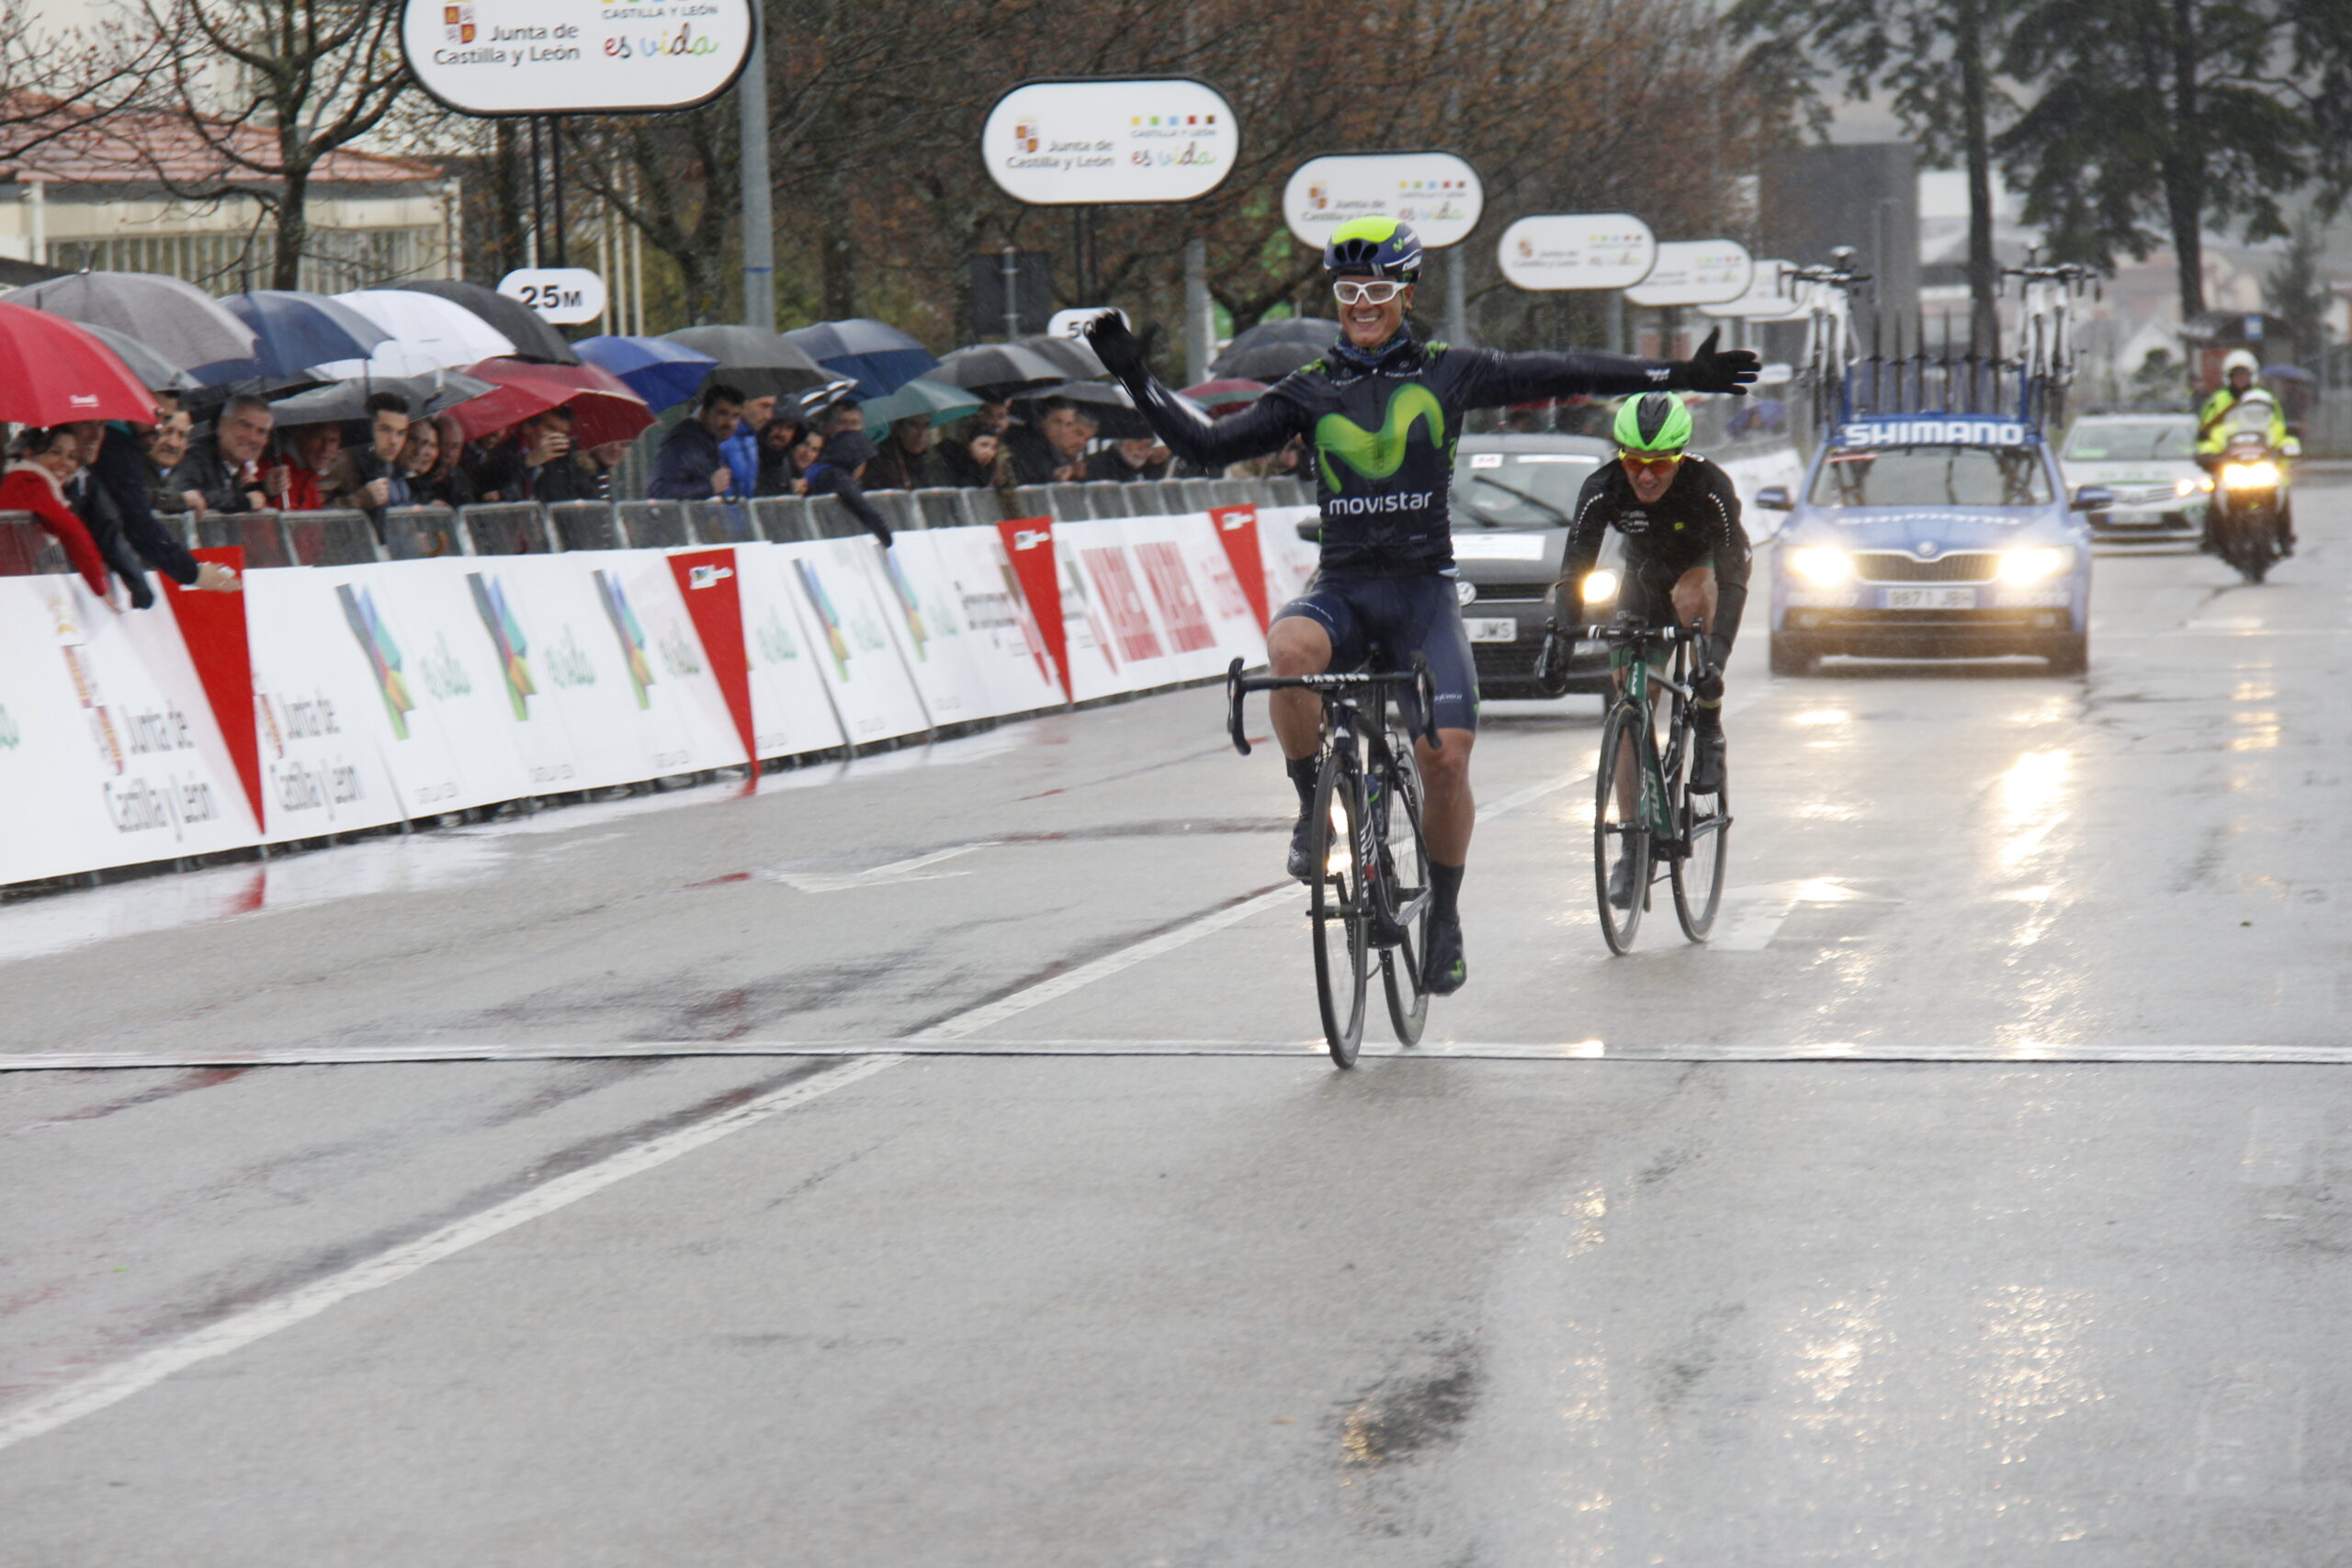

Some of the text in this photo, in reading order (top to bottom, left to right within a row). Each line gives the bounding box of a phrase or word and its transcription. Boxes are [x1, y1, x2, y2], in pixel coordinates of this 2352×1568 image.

[603, 7, 663, 18] CASTILLA
[669, 7, 677, 17] Y
[490, 22, 579, 41] Junta de
[604, 21, 718, 59] es vida
[434, 44, 581, 67] Castilla y León
[1048, 139, 1114, 152] Junta de
[1131, 140, 1217, 167] es vida
[1006, 155, 1059, 168] Castilla
[1845, 421, 2025, 446] SHIMANO
[1329, 491, 1432, 516] movistar
